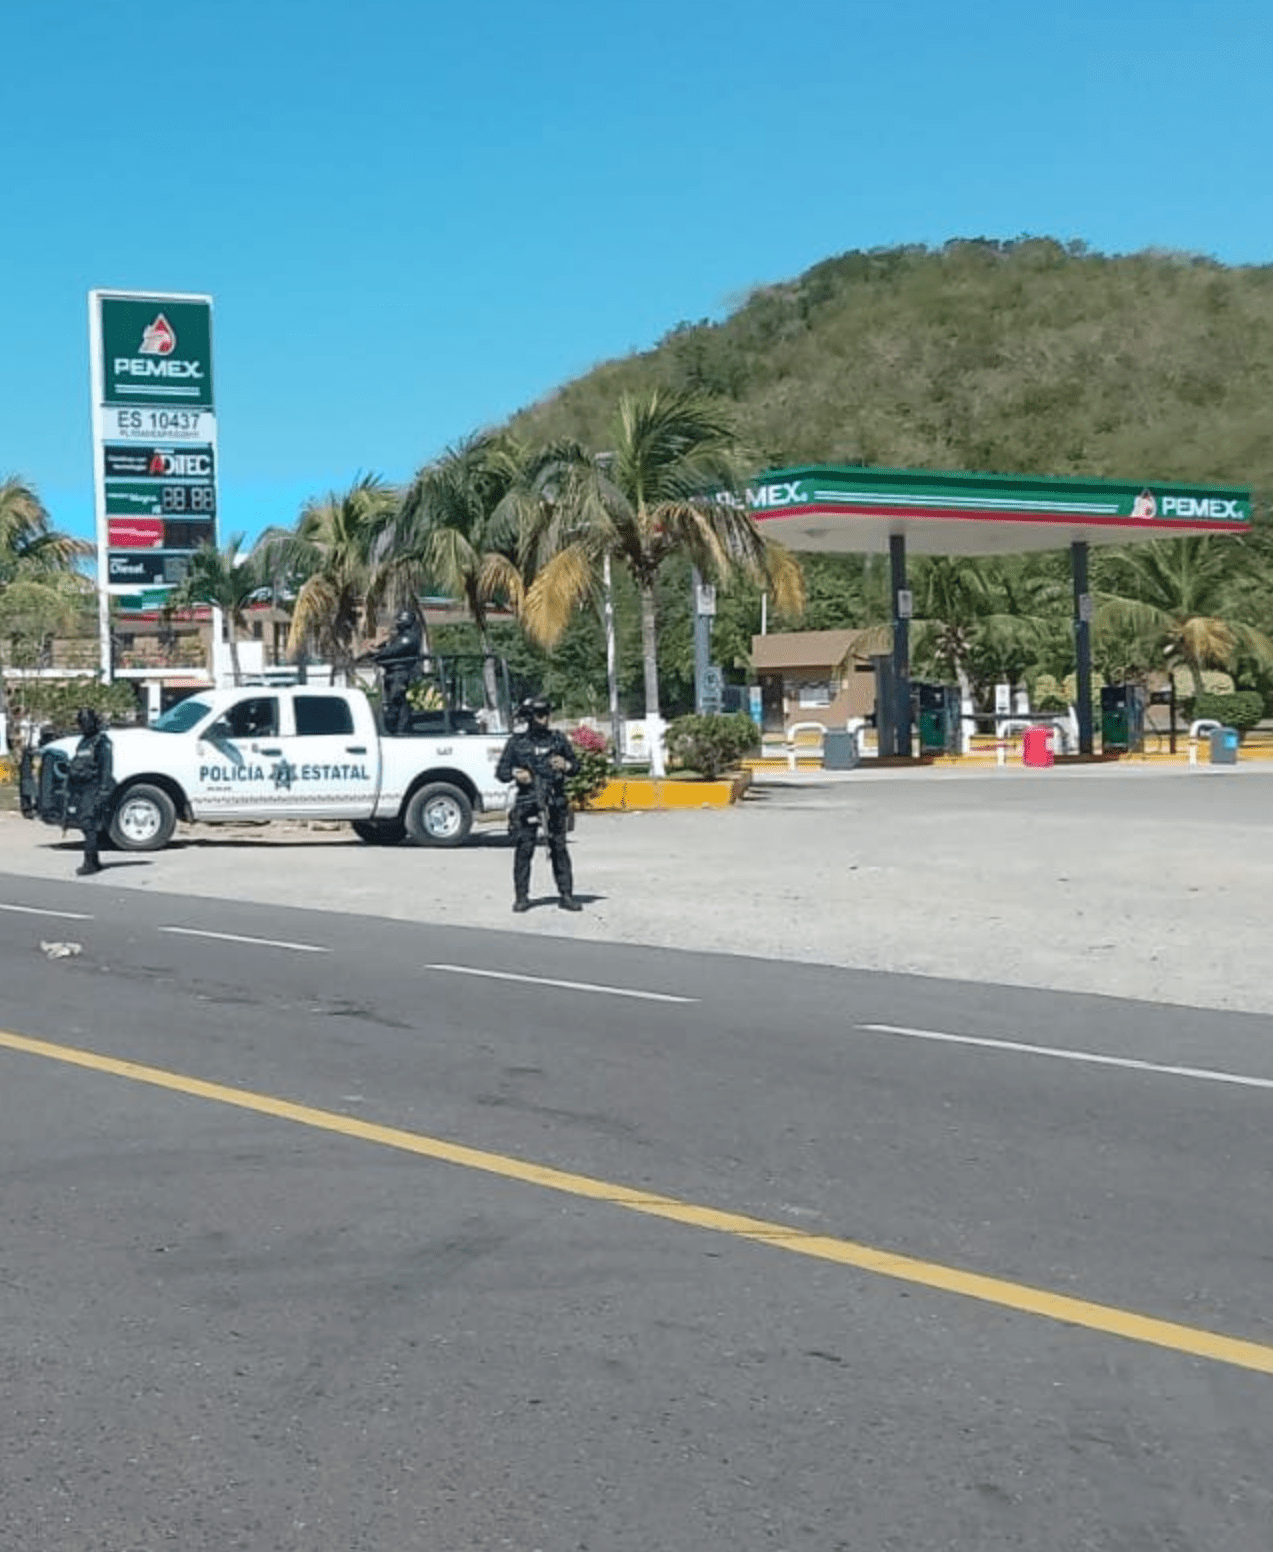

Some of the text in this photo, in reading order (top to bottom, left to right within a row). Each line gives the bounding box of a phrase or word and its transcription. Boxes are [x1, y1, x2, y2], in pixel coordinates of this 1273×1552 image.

[114, 357, 201, 378] PEMEX
[117, 411, 201, 430] ES 10437
[1162, 496, 1239, 518] PEMEX
[301, 764, 370, 781] ESTATAL
